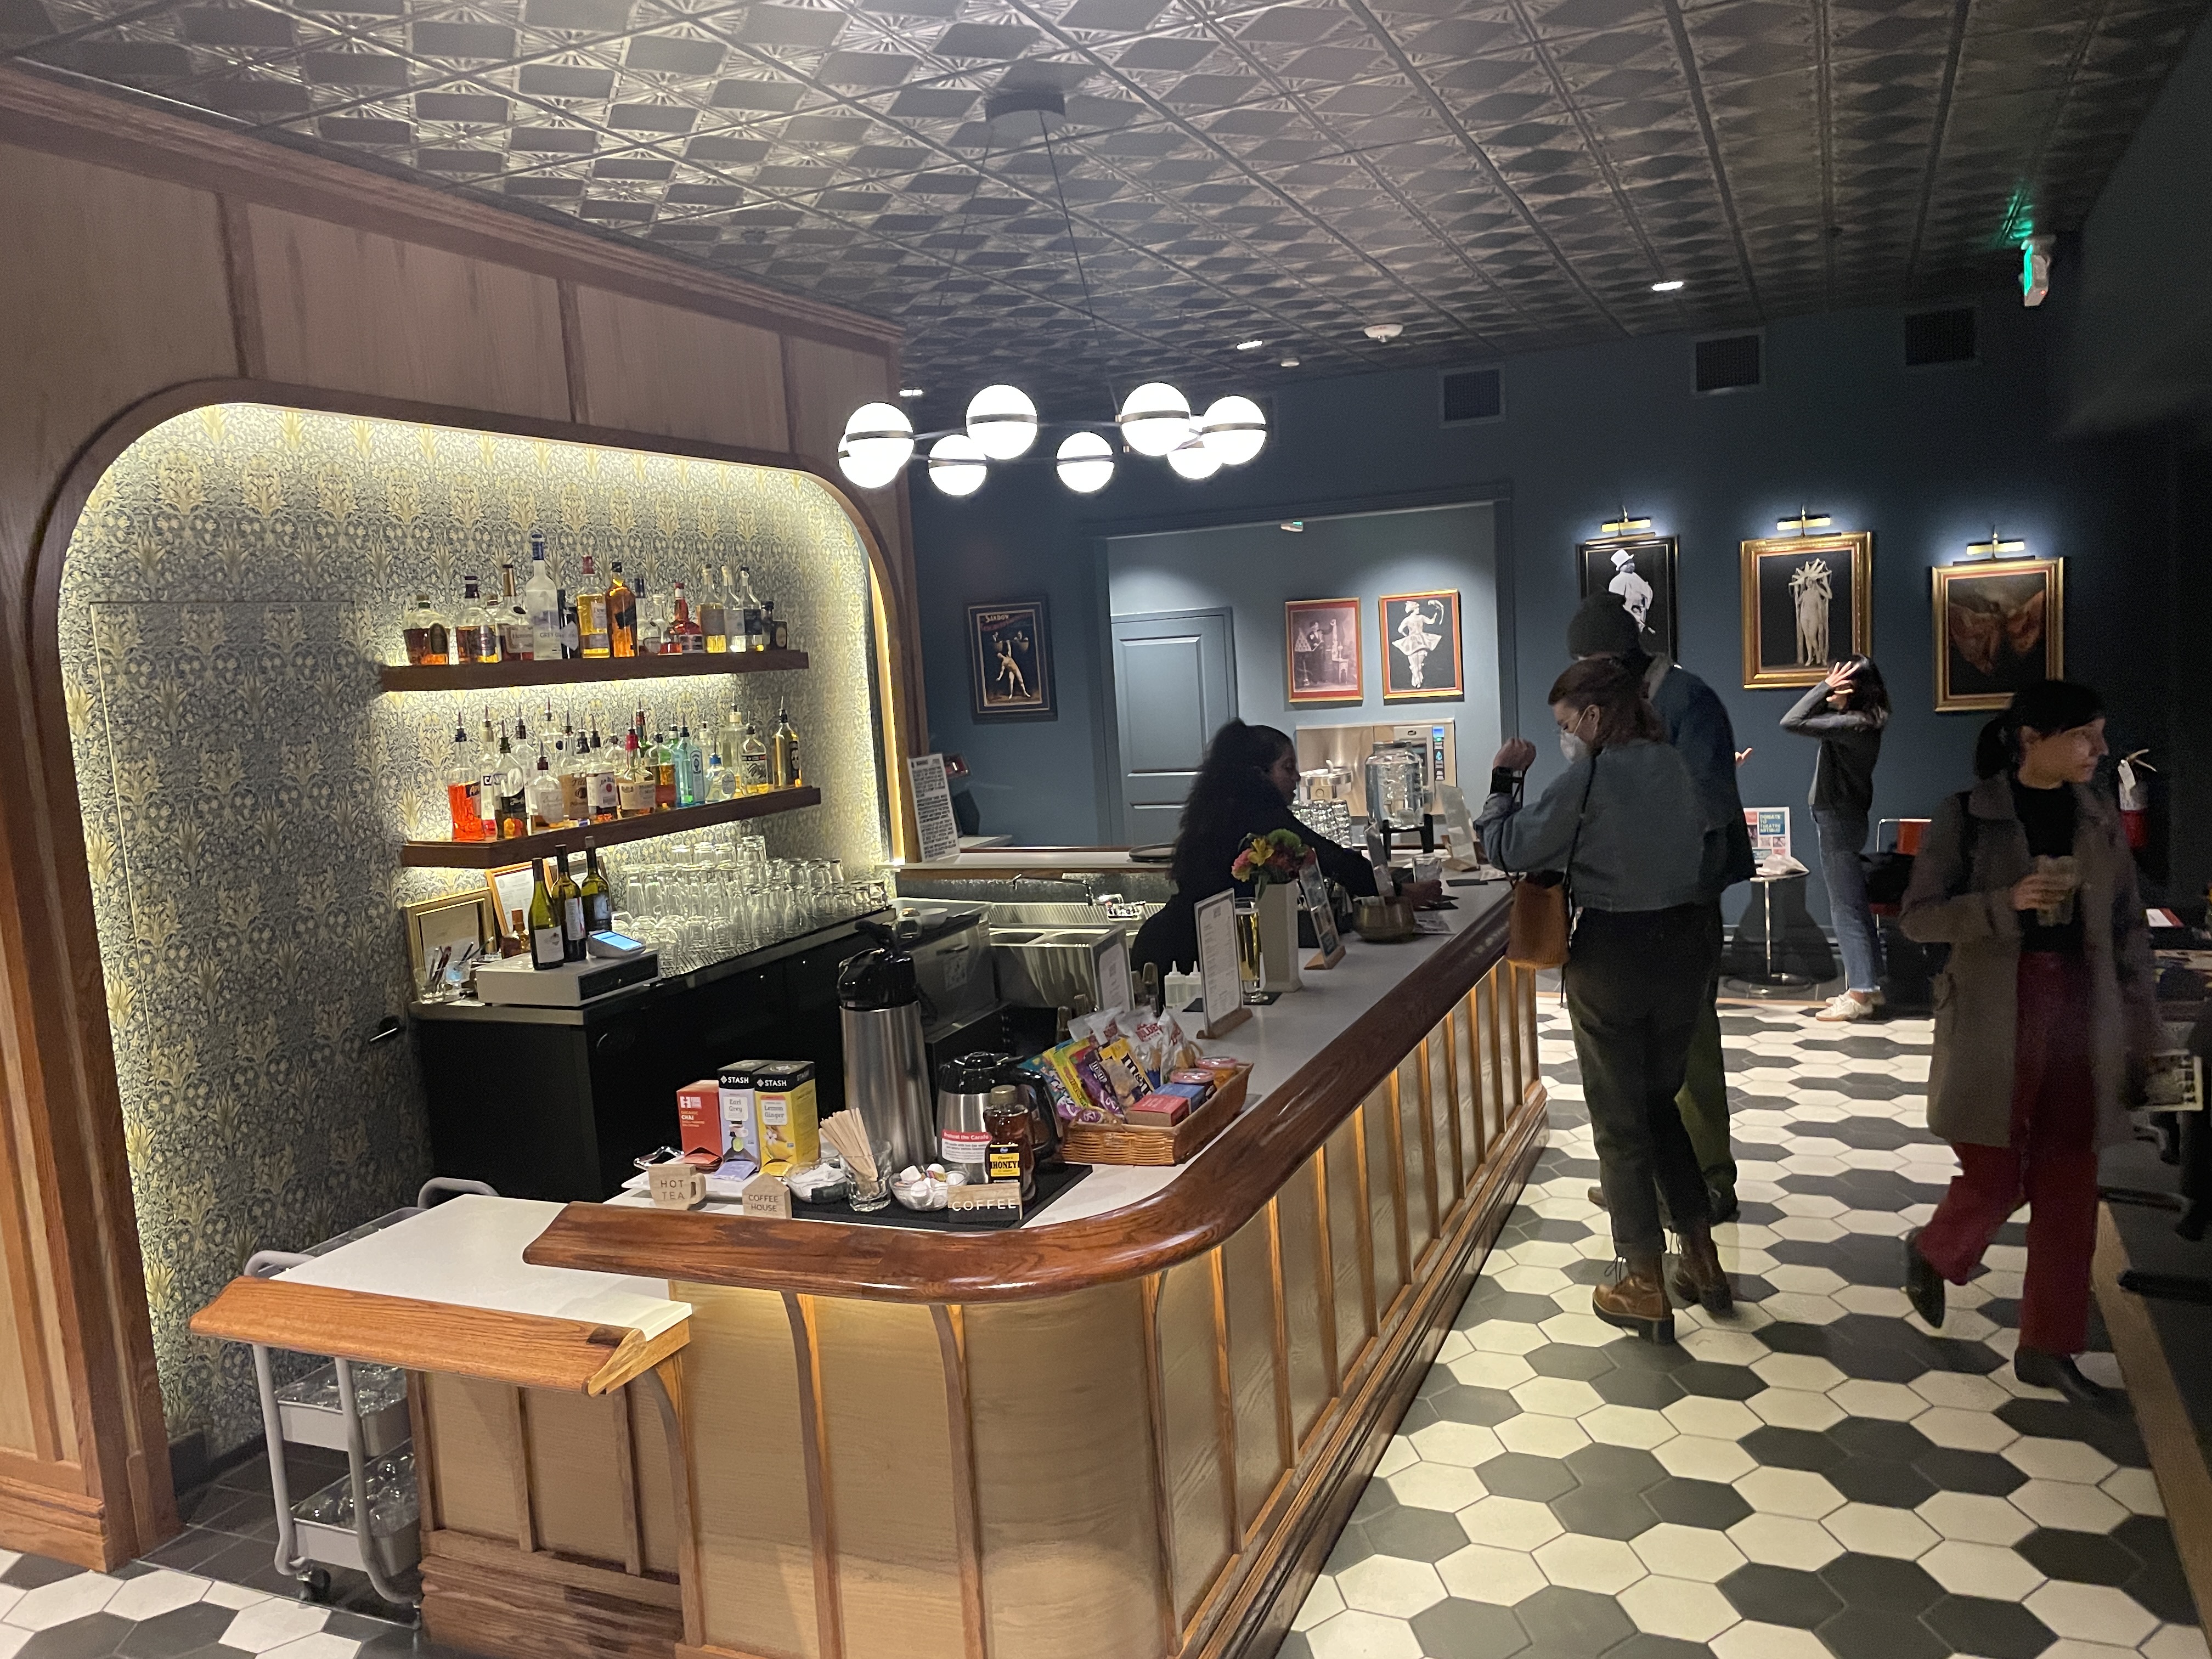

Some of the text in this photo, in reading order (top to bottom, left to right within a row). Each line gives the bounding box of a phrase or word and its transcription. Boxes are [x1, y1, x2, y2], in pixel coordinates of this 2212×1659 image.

[993, 1161, 1017, 1169] HONEY
[661, 1180, 684, 1188] HOT
[662, 1191, 685, 1200] TEA
[748, 1194, 778, 1203] COFFEE
[751, 1203, 777, 1212] HOUSE
[952, 1198, 1017, 1211] COFFEE
